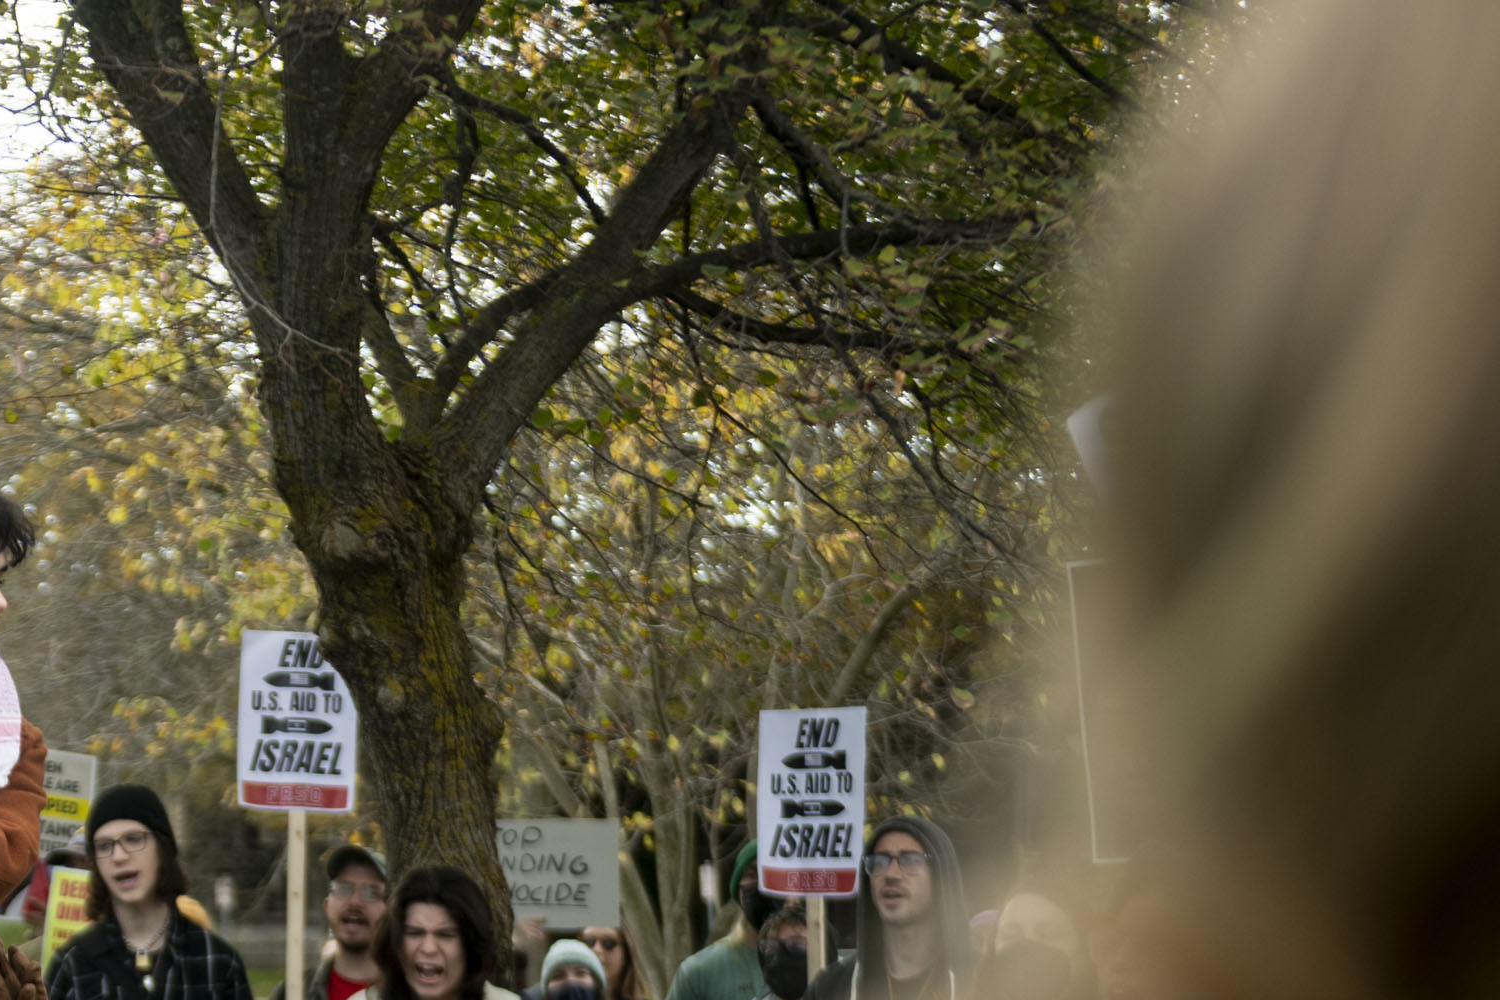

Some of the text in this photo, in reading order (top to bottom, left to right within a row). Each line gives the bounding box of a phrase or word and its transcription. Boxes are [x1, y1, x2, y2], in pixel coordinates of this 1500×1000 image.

[251, 690, 342, 714] U.S. AID TO
[795, 717, 840, 749] END
[249, 739, 343, 775] ISRAEL
[770, 771, 853, 795] U.S. AID TO
[496, 825, 542, 849] OP
[769, 823, 853, 858] ISRAEL
